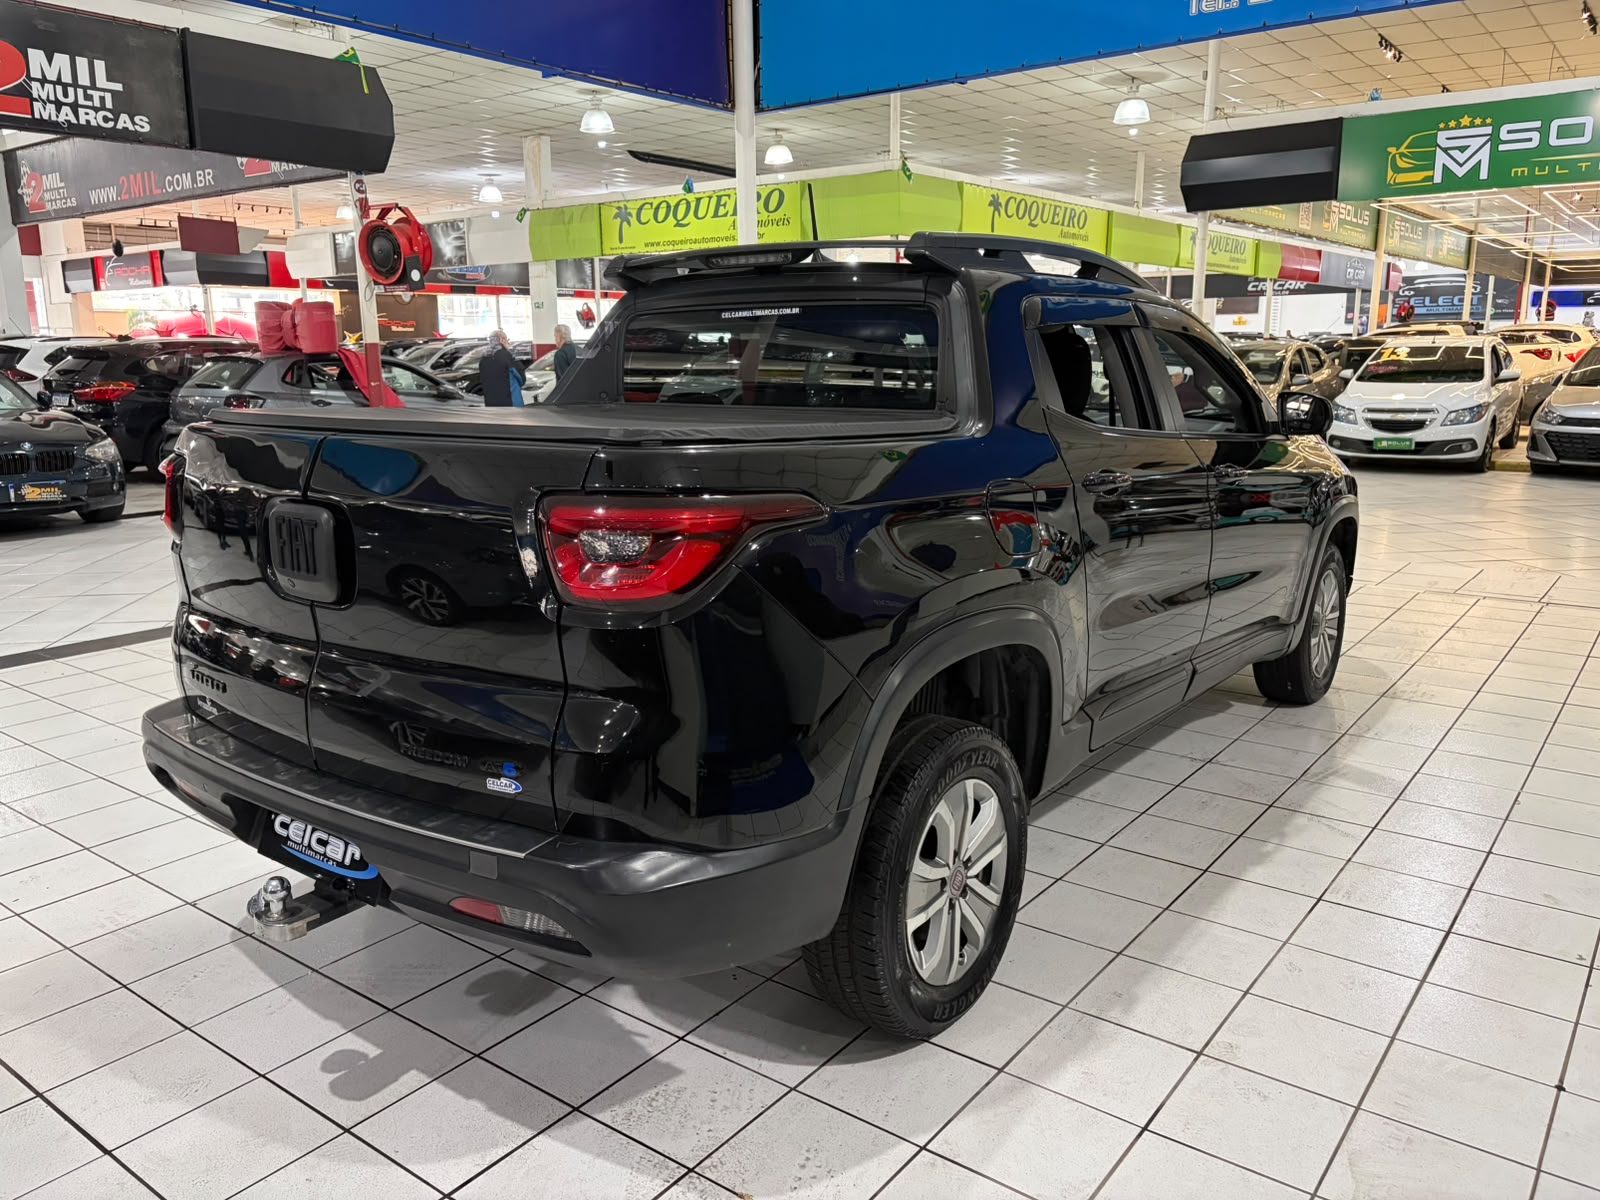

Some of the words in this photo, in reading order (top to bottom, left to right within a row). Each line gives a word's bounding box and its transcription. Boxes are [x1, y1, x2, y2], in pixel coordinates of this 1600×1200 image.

[27, 48, 123, 91] MIL
[31, 81, 113, 109] MULTI
[32, 101, 151, 133] MARCAS
[1497, 115, 1594, 152] SO
[42, 172, 65, 188] MIL
[89, 168, 215, 205] WWW.2MIL.COM.BR
[44, 188, 68, 201] MULTI
[45, 197, 77, 212] MARCAS
[1004, 196, 1088, 230] COQUEIRO
[1340, 203, 1370, 225] SOLUS
[644, 231, 765, 249] www.coqueiroautomoveis.br
[1207, 232, 1247, 256] QUEIRO
[1273, 280, 1307, 291] CAR
[275, 514, 318, 577] FIAT
[400, 741, 469, 768] FREEDOM
[273, 813, 361, 867] celcar
[287, 840, 338, 867] multimarcas
